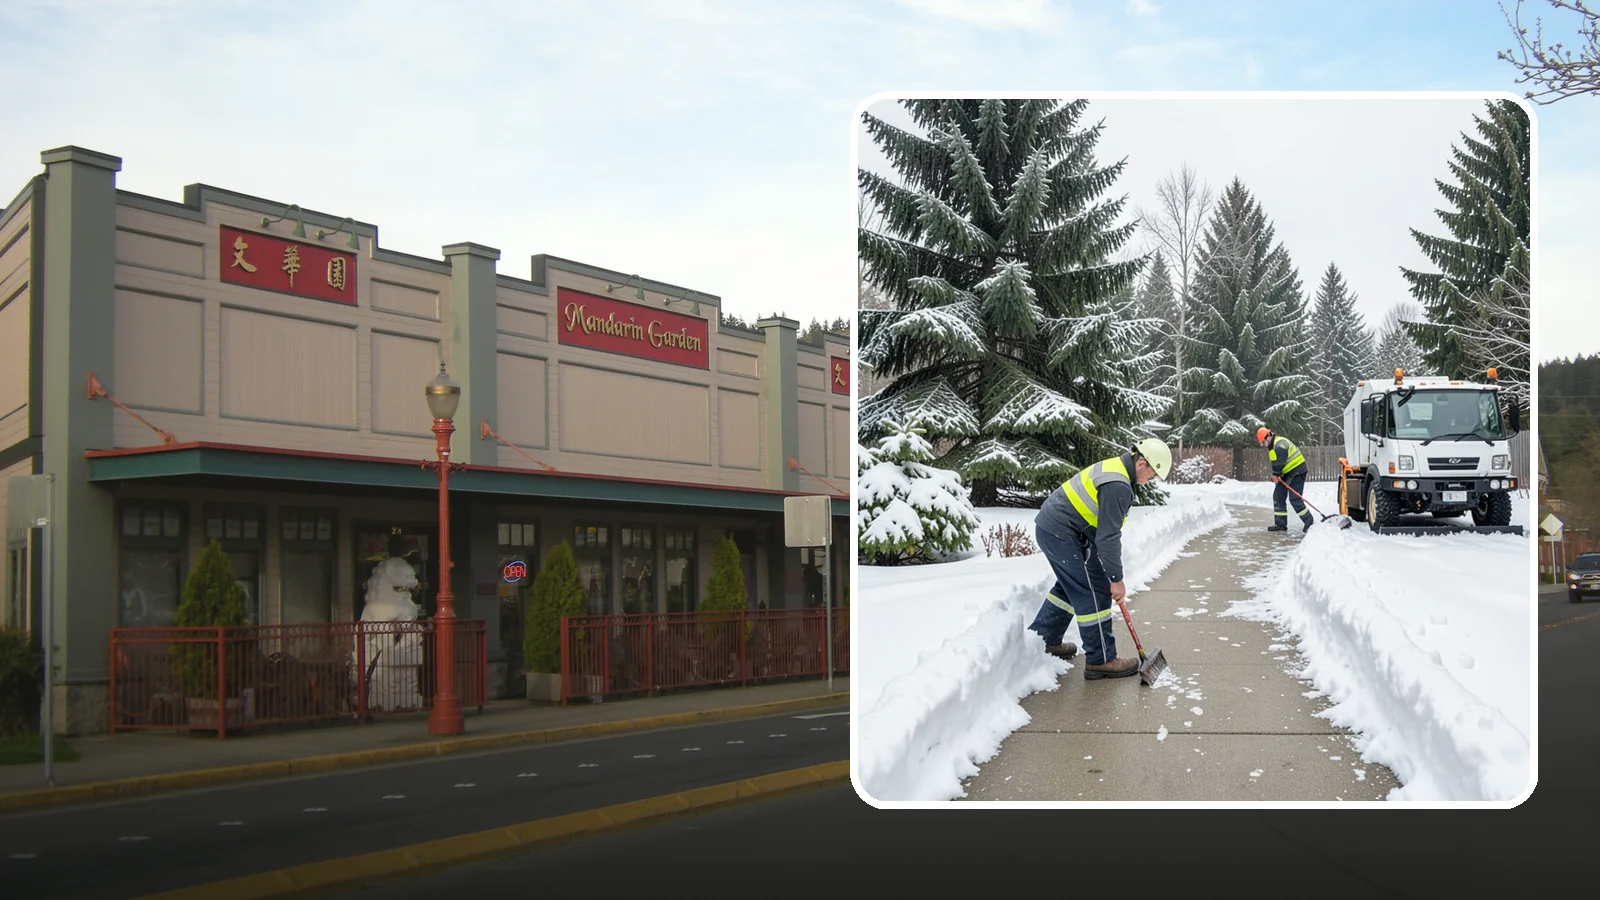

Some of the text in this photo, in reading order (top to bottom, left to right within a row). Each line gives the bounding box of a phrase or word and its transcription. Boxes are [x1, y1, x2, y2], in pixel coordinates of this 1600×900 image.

[231, 236, 346, 291] 文華園
[564, 302, 701, 352] Mandarin Garden
[835, 363, 846, 386] 文
[503, 565, 526, 578] OPEN
